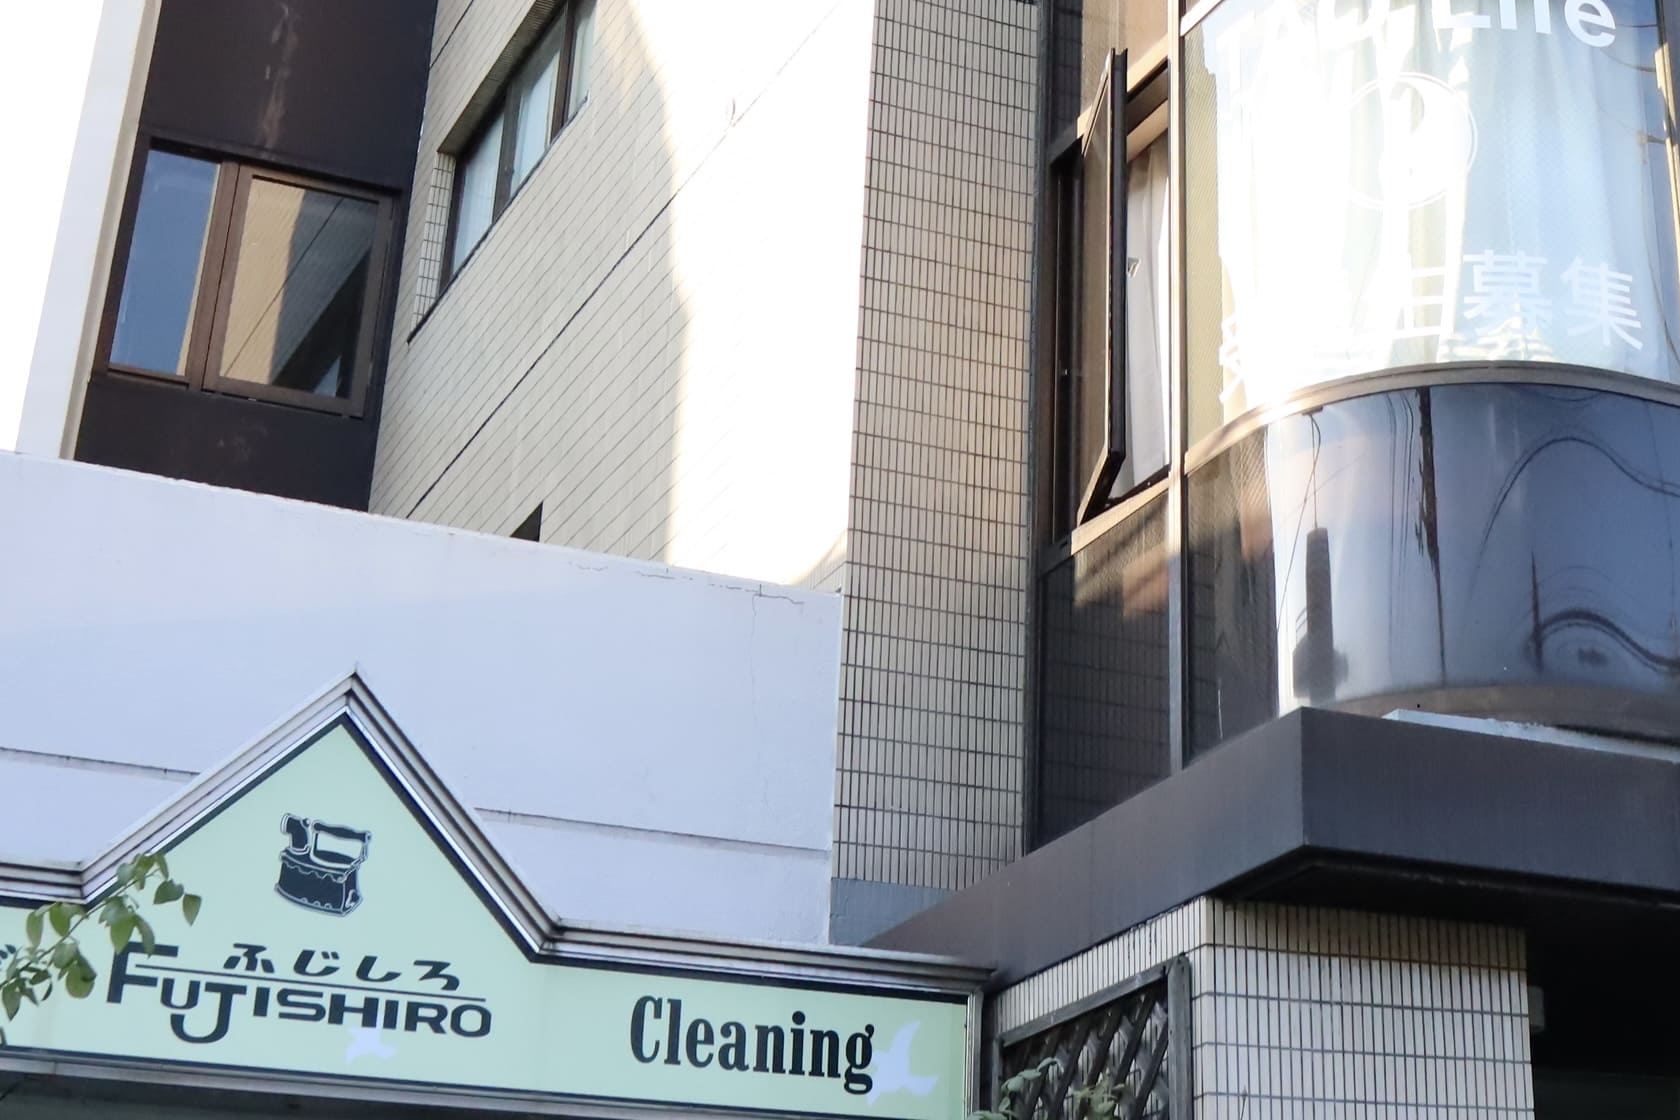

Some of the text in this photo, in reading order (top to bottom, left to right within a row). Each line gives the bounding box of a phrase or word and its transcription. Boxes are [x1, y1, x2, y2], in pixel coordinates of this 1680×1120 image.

[222, 942, 462, 993] ふじしろ
[629, 993, 876, 1096] Cleaning
